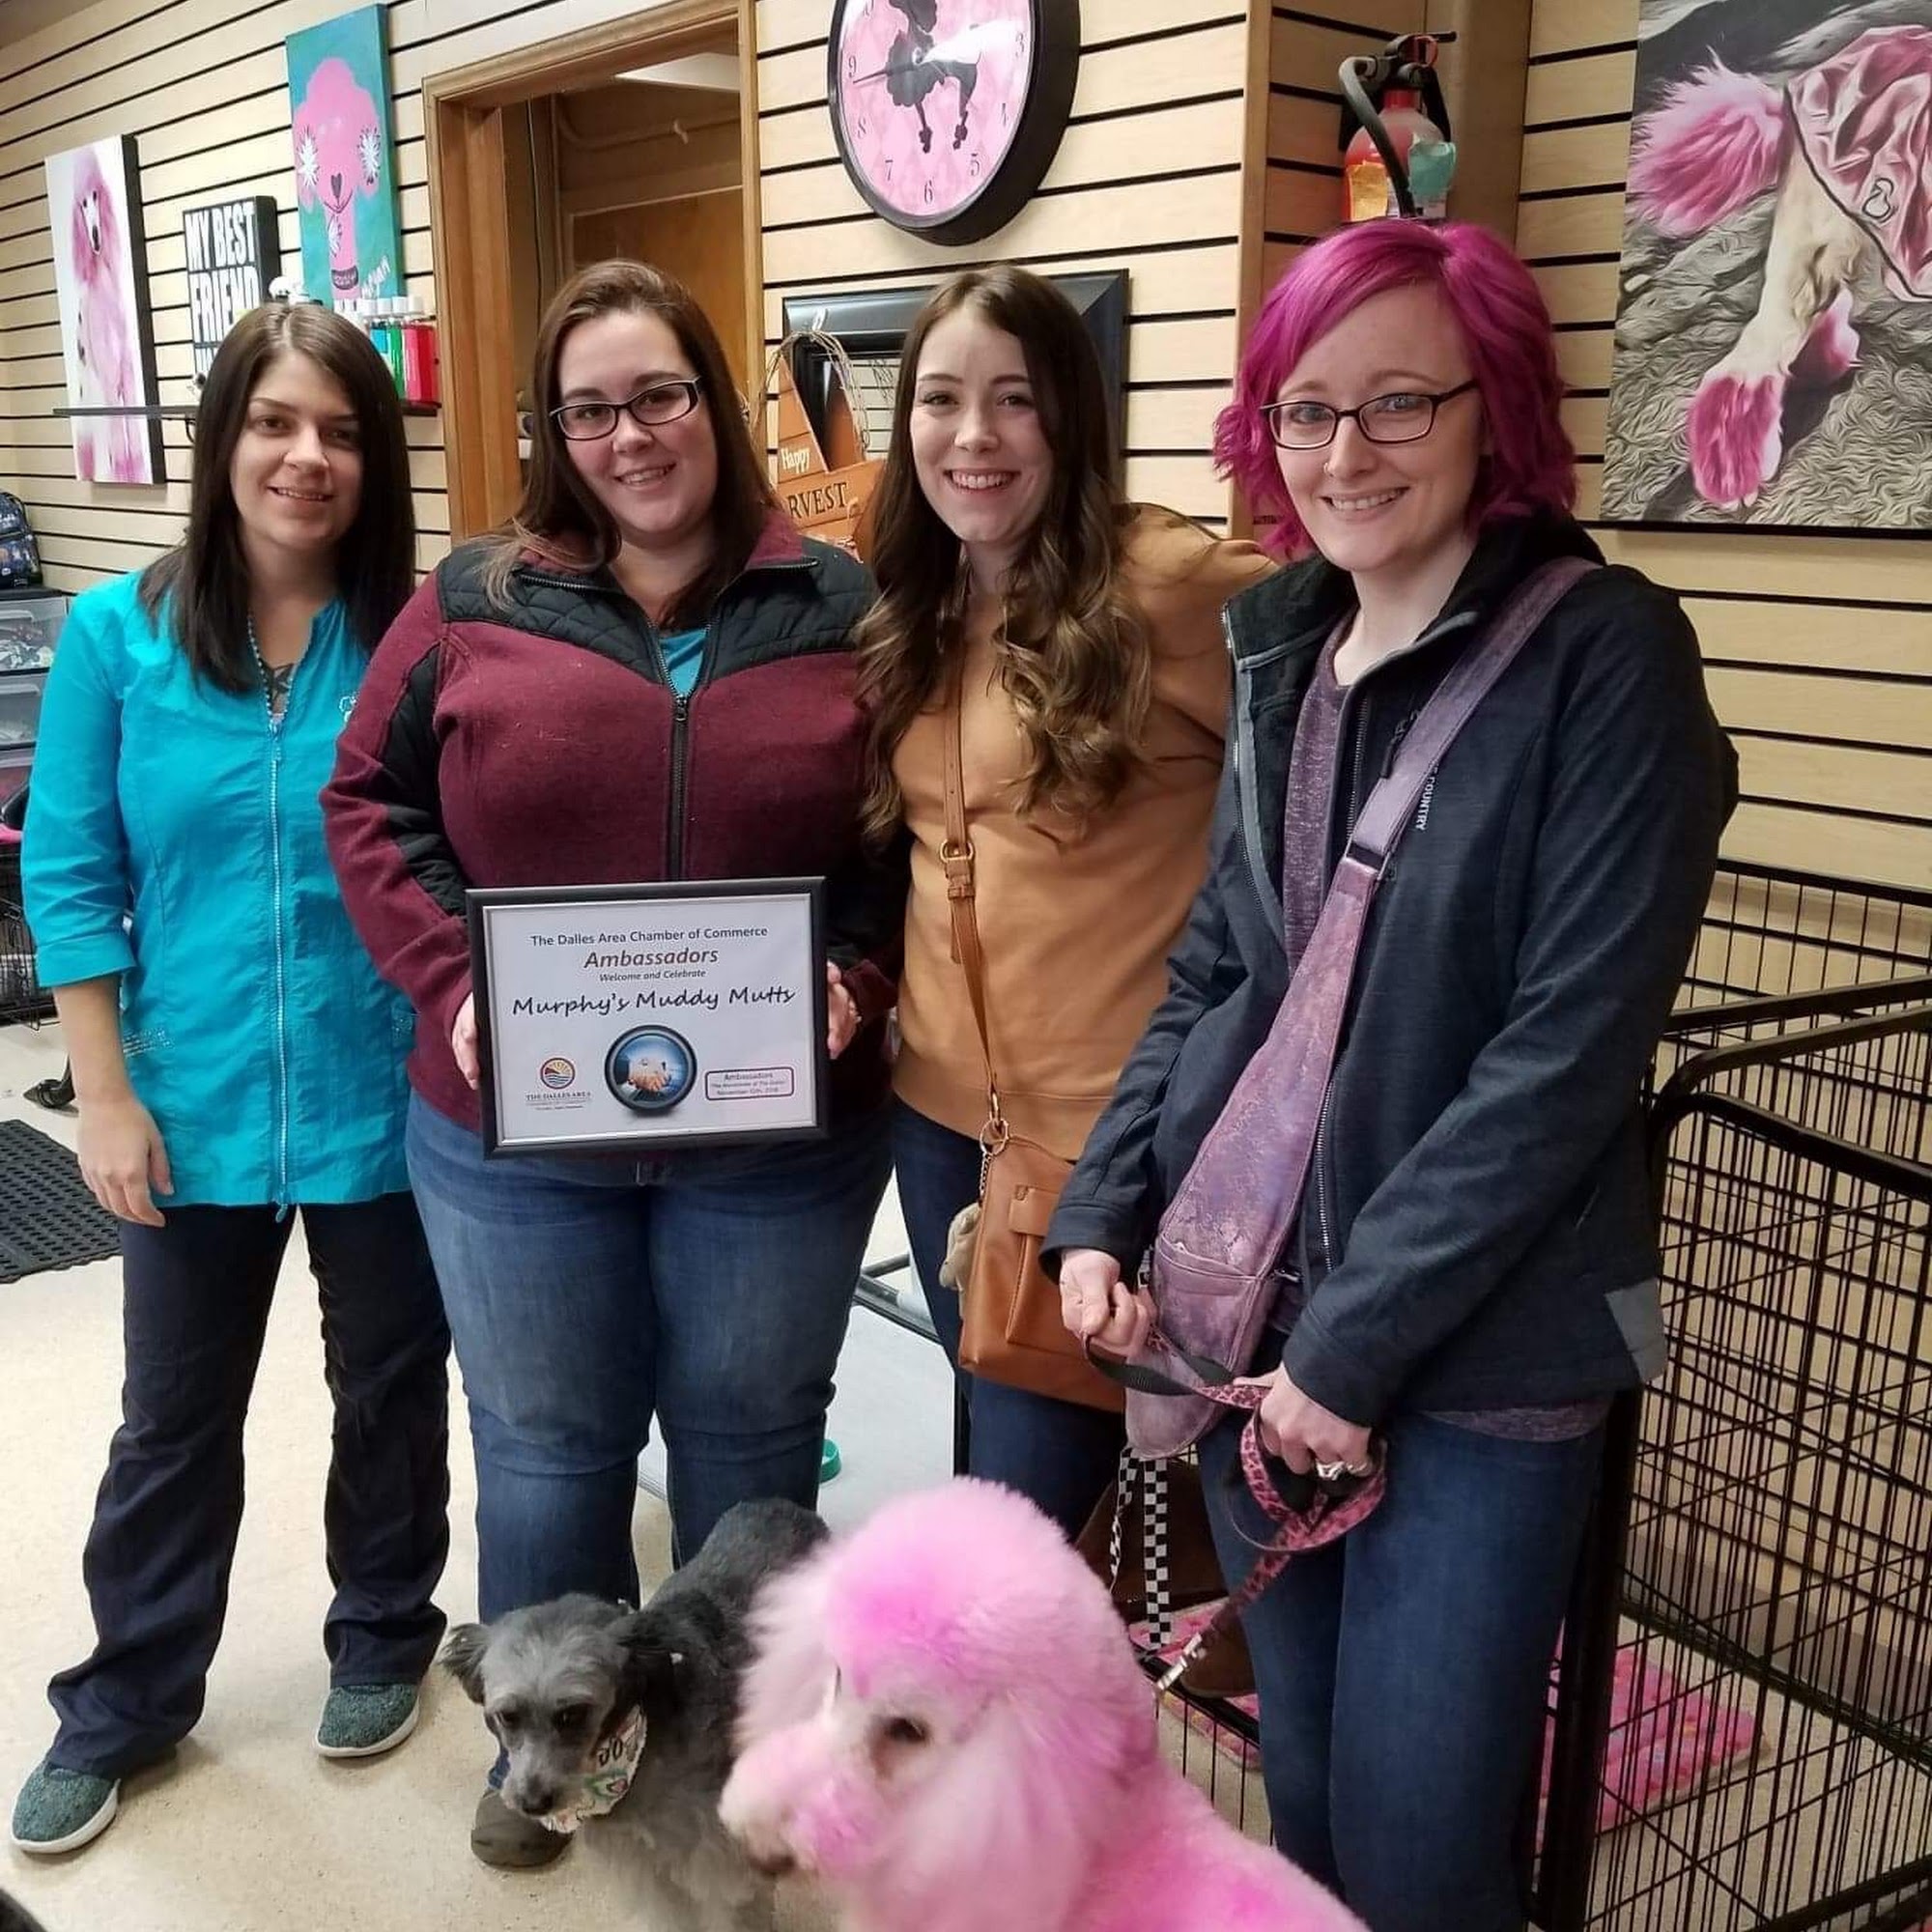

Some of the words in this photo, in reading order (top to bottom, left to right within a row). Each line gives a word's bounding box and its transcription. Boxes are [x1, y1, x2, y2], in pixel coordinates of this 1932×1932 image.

[847, 55, 858, 77] 9
[884, 159, 894, 182] 7
[970, 153, 980, 177] 5
[923, 179, 934, 205] 6
[185, 208, 211, 271] MY
[212, 201, 256, 268] BEST
[781, 447, 810, 473] Happy
[787, 482, 847, 520] RVEST
[531, 935, 554, 947] The
[557, 934, 595, 946] Dalles
[598, 933, 627, 944] Area
[630, 930, 684, 942] Chamber
[688, 928, 700, 939] of
[703, 927, 768, 939] Commerce
[583, 947, 719, 968] Ambassadors
[600, 971, 641, 981] Welcome
[643, 970, 661, 980] and
[664, 969, 706, 980] Celebrate
[513, 992, 630, 1017] Murphy's
[636, 988, 719, 1009] Muddy
[728, 985, 796, 1005] Mutts
